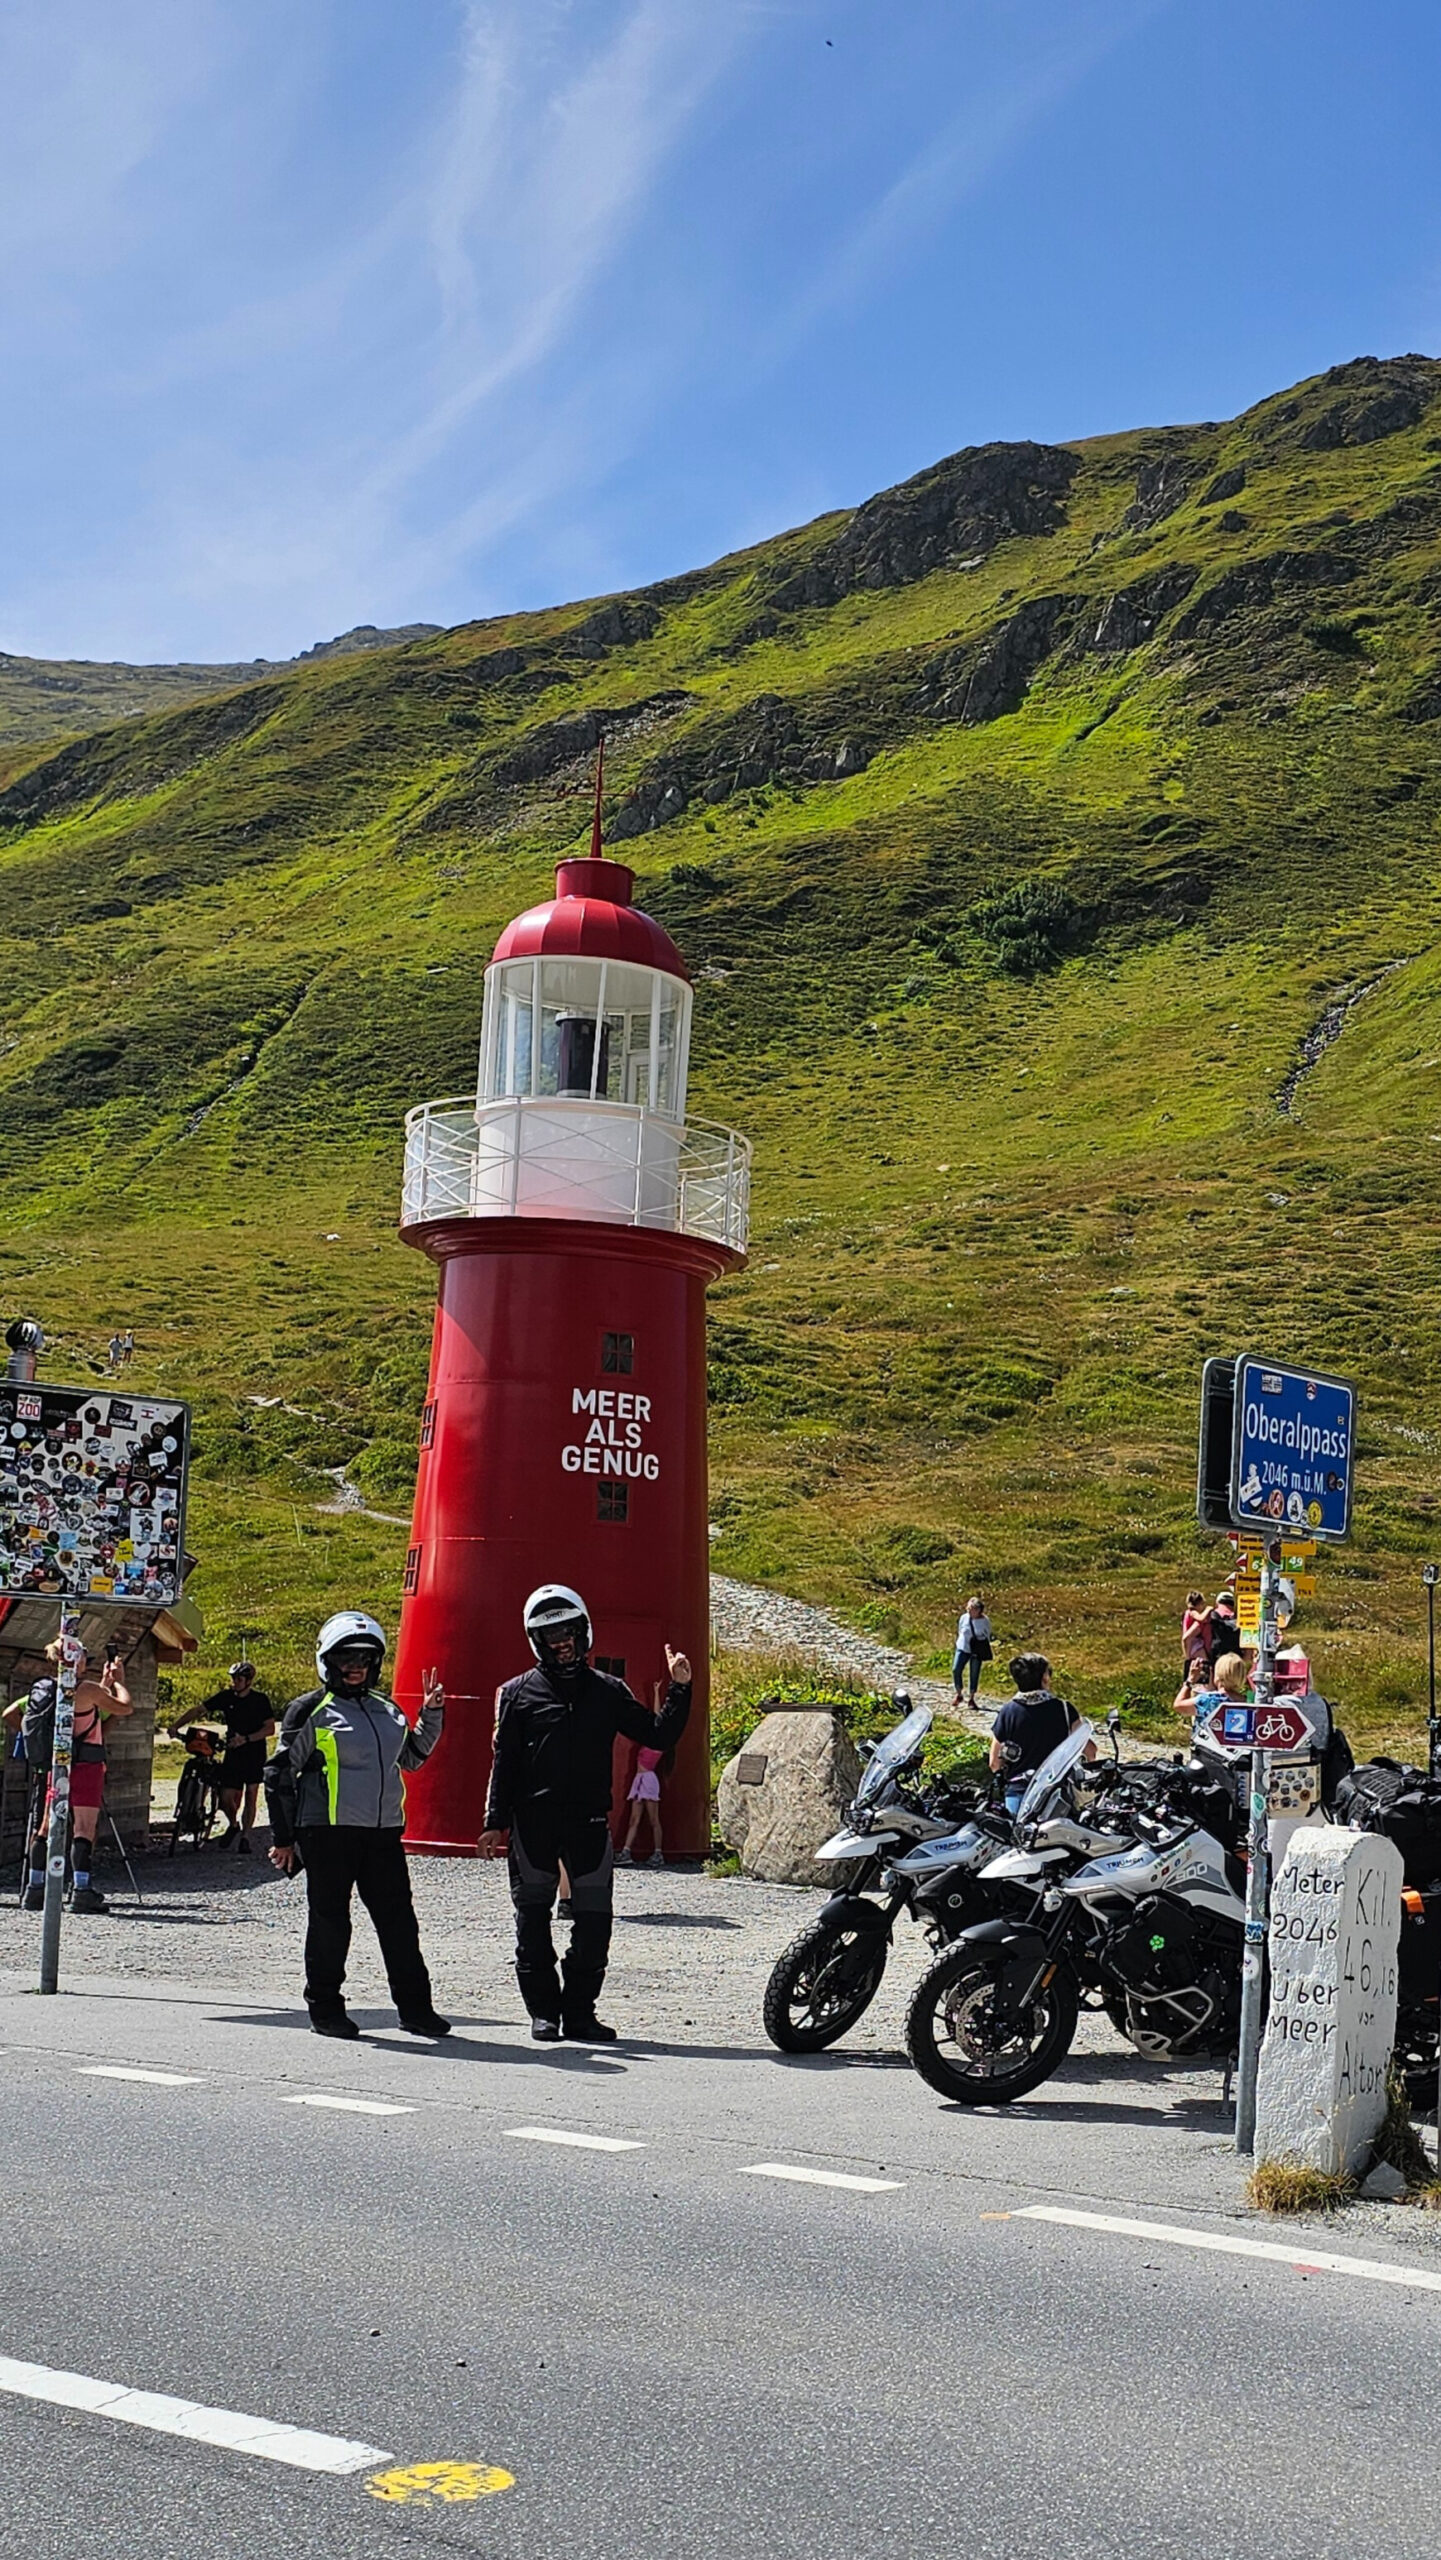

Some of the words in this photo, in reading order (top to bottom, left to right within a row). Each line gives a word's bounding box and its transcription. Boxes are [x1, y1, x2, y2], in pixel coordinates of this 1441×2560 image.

[18, 1402, 40, 1418] 200
[572, 1388, 652, 1423] MEER
[584, 1418, 642, 1449] ALS
[1246, 1403, 1346, 1463] Oberalppass
[561, 1445, 660, 1481] GENUG
[1262, 1461, 1289, 1488] 2046
[1231, 1713, 1246, 1733] 2
[934, 1840, 968, 1851] TRIUMPH
[1106, 1857, 1144, 1869] TRIUMPH
[1273, 1866, 1345, 1895] Meter
[1273, 1913, 1338, 1949] 2046
[1272, 1966, 1340, 2005] Über
